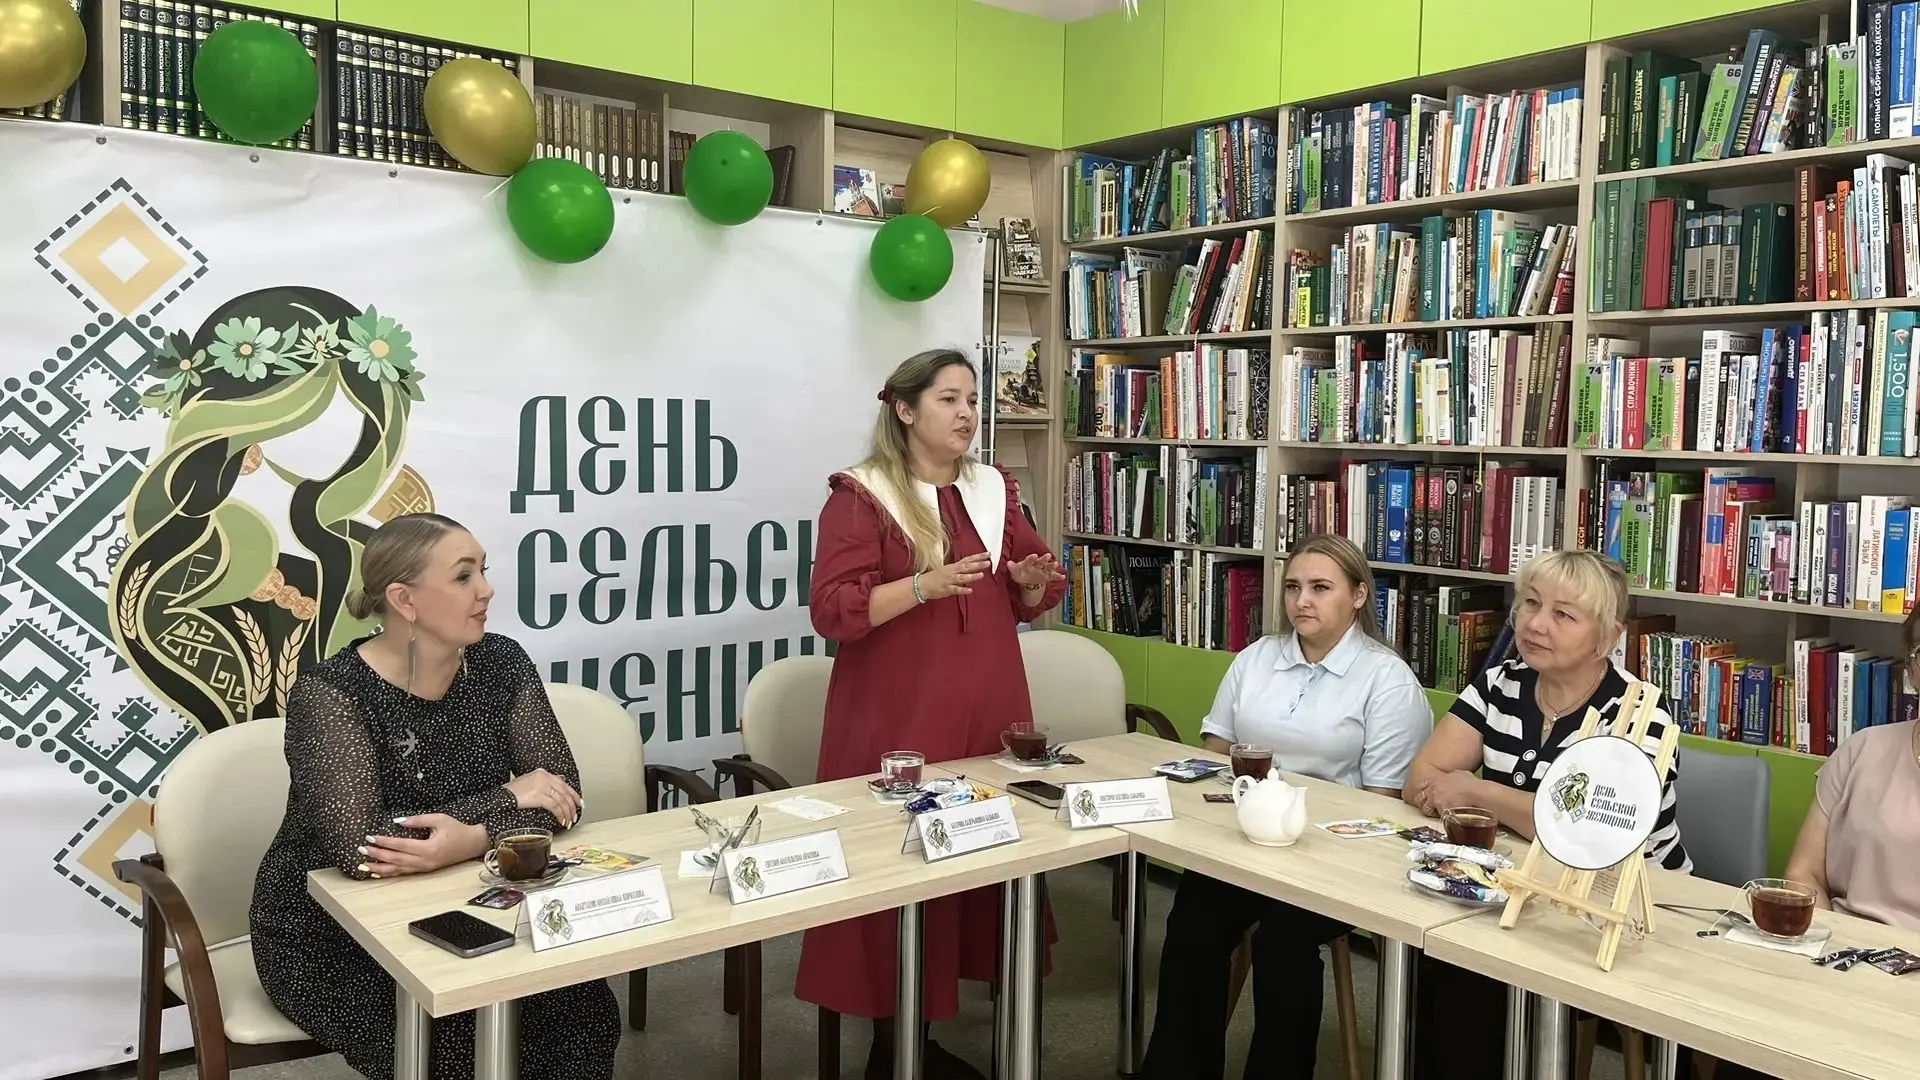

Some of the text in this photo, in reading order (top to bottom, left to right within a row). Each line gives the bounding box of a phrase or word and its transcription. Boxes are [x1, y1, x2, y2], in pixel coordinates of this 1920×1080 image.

[1841, 50, 1856, 61] 67
[1874, 12, 1882, 56] КОДЕКСОВ
[1727, 68, 1741, 78] 66
[1765, 59, 1781, 106] САТАНОВСКИЙ
[1874, 57, 1882, 96] СБОРНИК
[1712, 89, 1729, 142] ПОЛИТОЛОГИЯ
[1872, 188, 1880, 237] САМОЛЕТЫ
[1627, 361, 1635, 409] СПРАВОЧНИК
[1754, 341, 1770, 441] ОЛИМПИЙСКИЕ ЧЕМПИОНЫ
[1797, 364, 1805, 409] СПАРТАК
[1892, 352, 1907, 398] 1,500
[510, 395, 738, 513] ДЕНЬ
[1634, 504, 1648, 513] 81
[1577, 526, 1585, 549] ЕССИ
[1871, 529, 1880, 576] ЛАТИНСКОГО
[1128, 556, 1172, 568] ЛОШАД
[1590, 797, 1637, 817] СЕЛЬСКОЙ
[1593, 784, 1616, 798] ДЕНЬ
[1586, 810, 1636, 831] ЖЕНЩИНЫ
